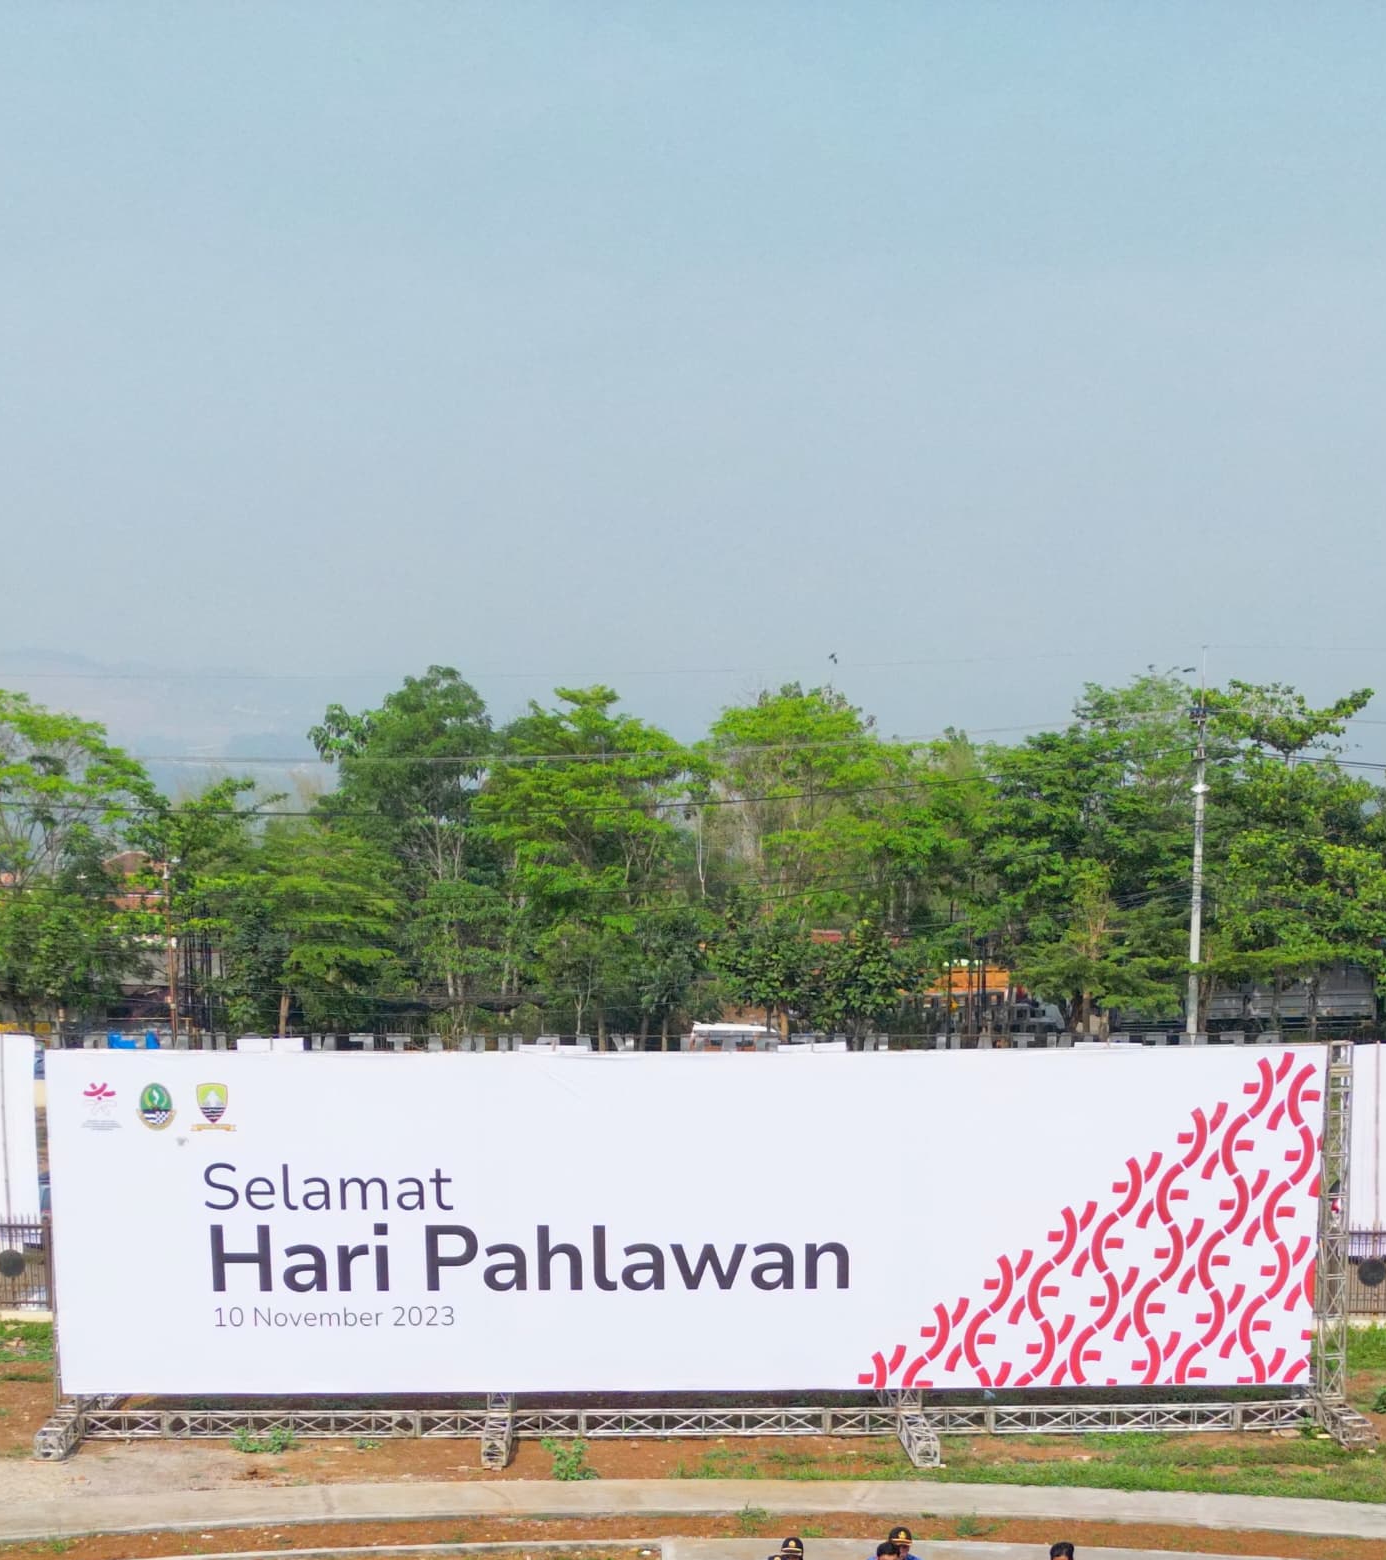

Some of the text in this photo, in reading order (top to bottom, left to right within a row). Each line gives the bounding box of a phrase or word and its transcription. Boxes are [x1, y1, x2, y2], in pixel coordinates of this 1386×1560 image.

[203, 1162, 454, 1211] Selamat
[210, 1222, 850, 1293] Hari Pahlawan
[215, 1305, 455, 1328] 10 November 2023
